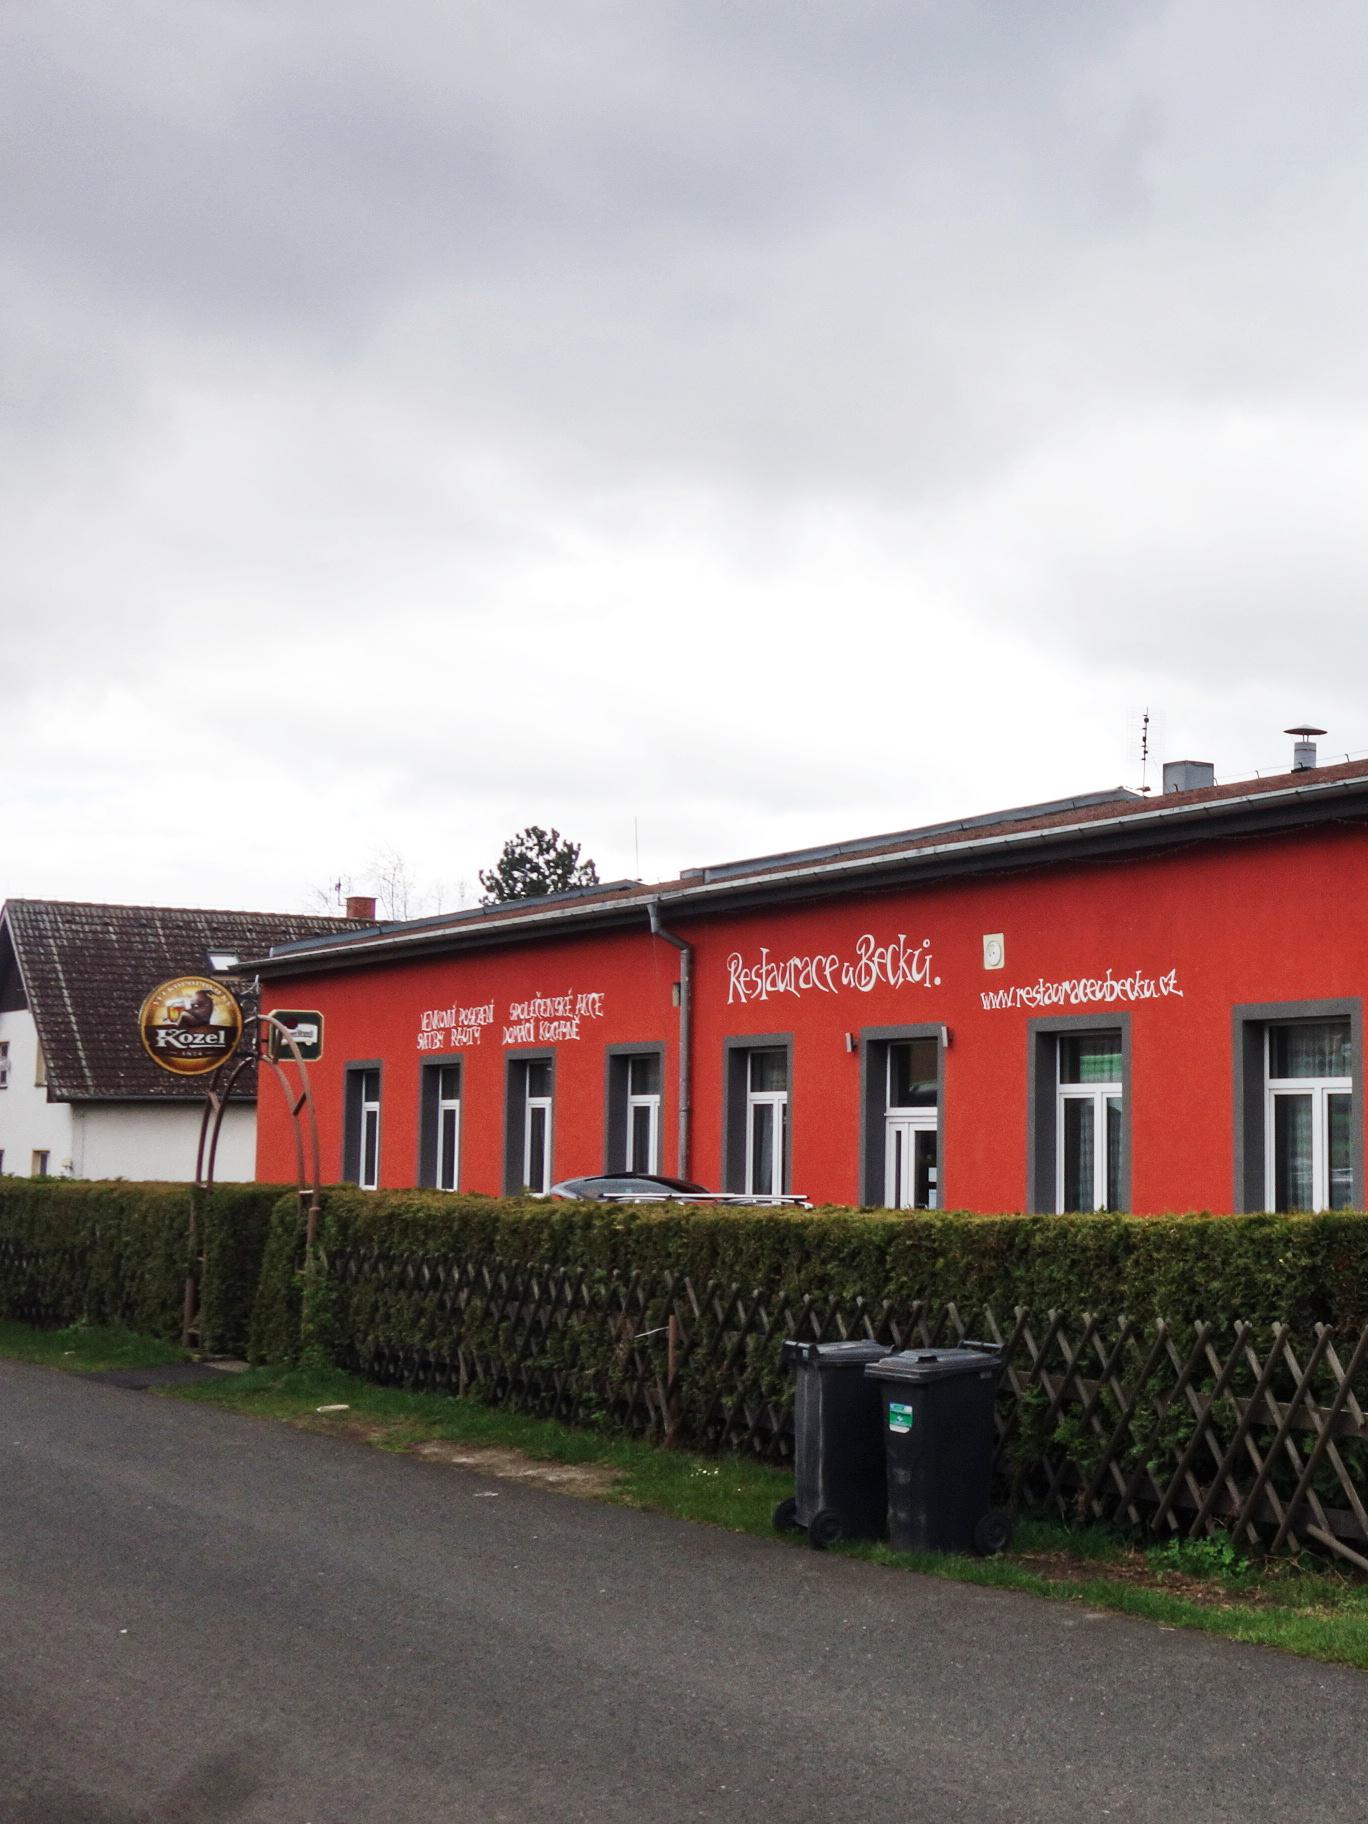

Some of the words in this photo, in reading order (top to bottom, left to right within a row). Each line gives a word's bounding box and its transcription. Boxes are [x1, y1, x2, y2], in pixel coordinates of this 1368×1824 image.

[727, 947, 839, 1004] Restaurace
[841, 962, 855, 987] u
[980, 968, 1183, 1010] www.restauraceubecku.cz
[509, 988, 574, 1020] SPOLEČENSKÉ
[575, 992, 605, 1018] AKCE
[155, 1028, 227, 1049] Kozel
[451, 1026, 480, 1046] RAUTY
[502, 1017, 535, 1045] DOMÁCÍ
